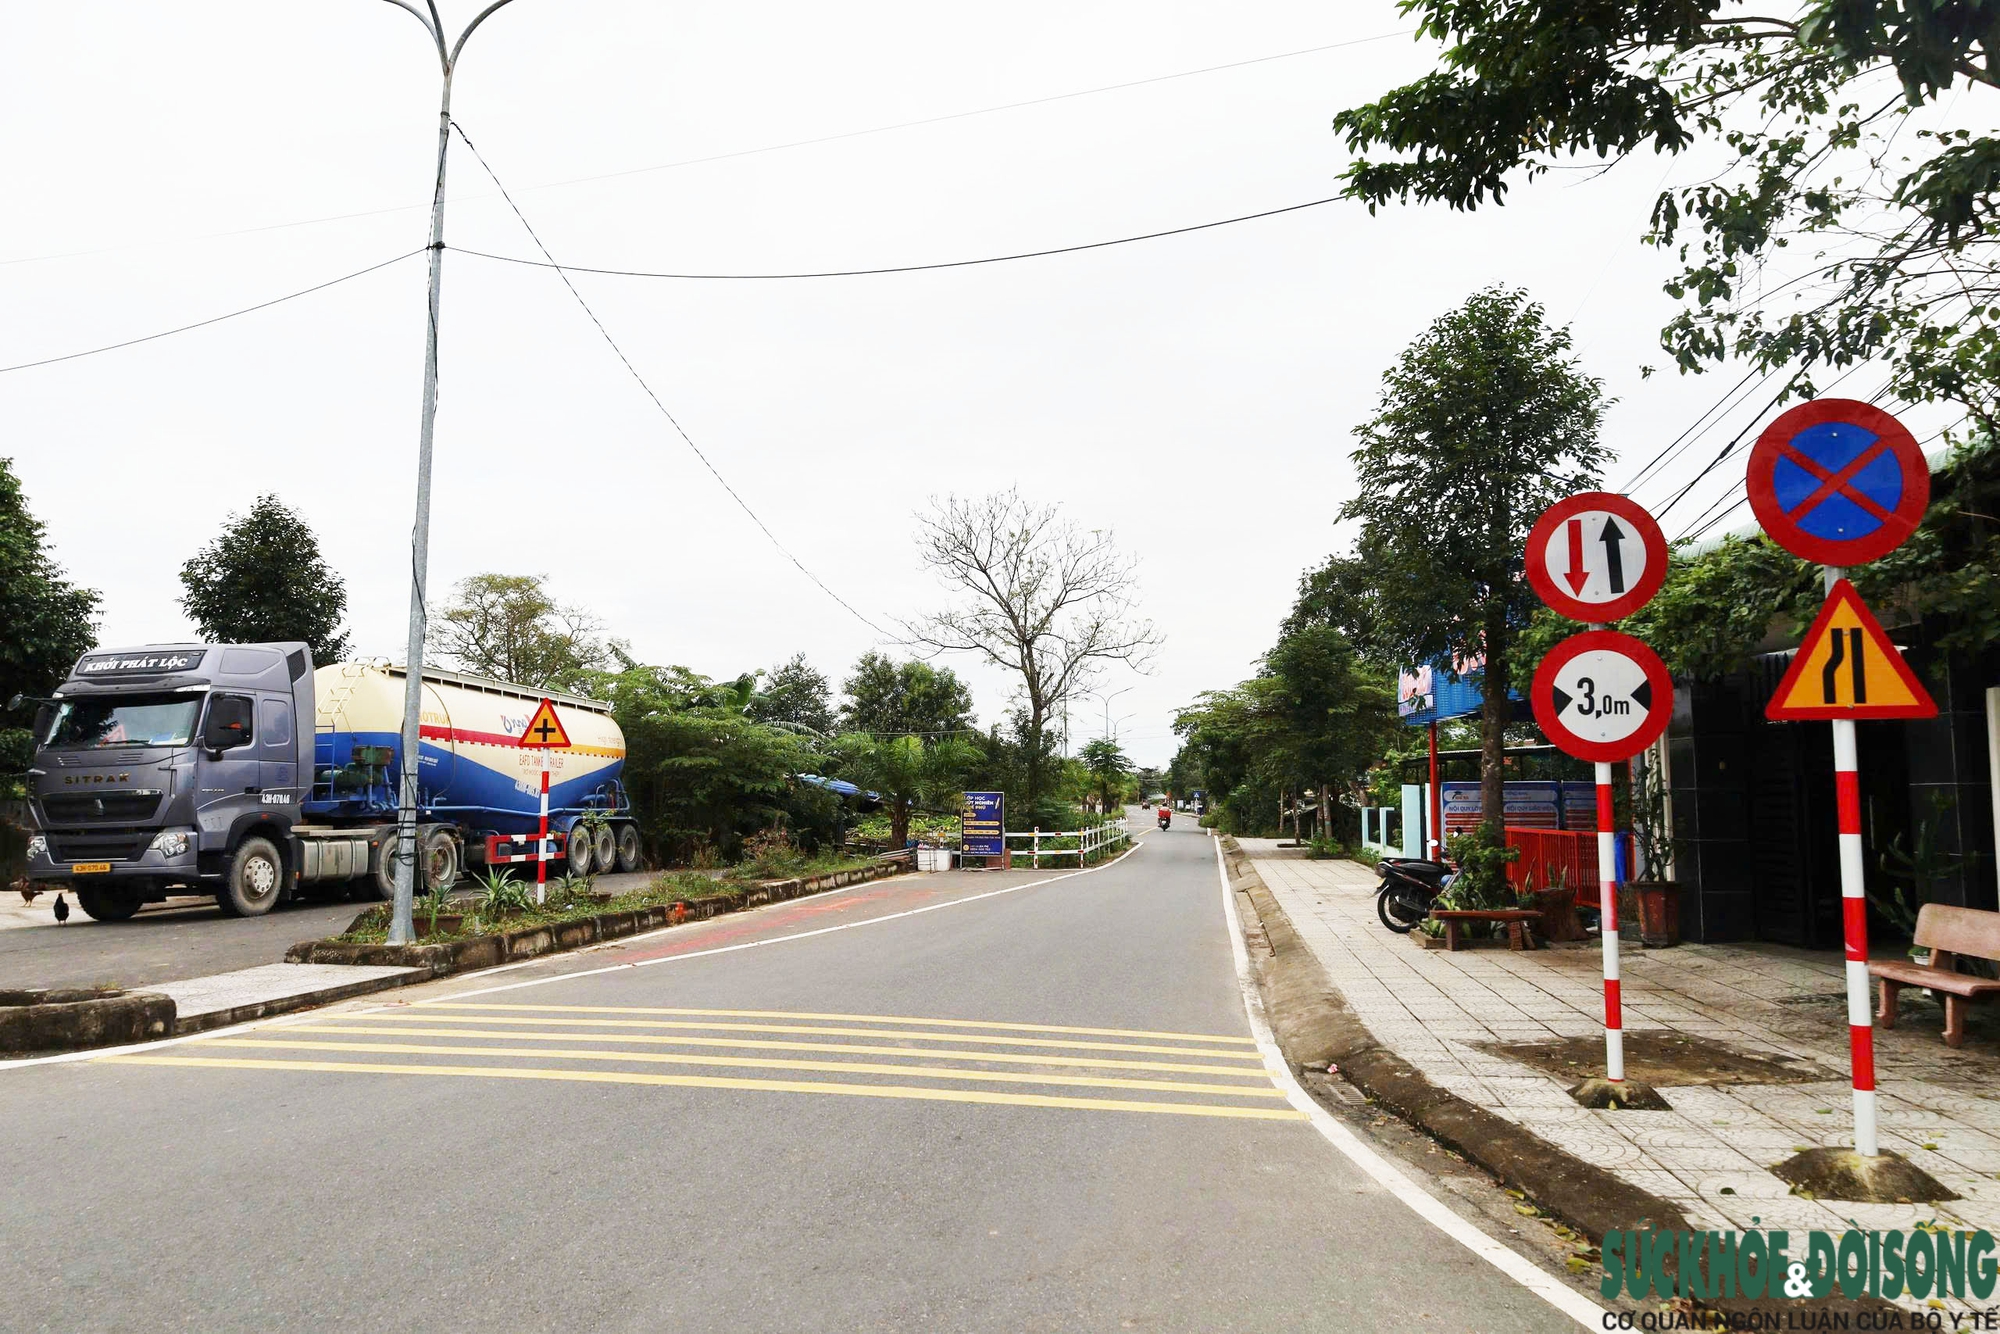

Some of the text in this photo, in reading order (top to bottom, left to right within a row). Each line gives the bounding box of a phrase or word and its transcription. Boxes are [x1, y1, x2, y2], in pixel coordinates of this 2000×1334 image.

[119, 655, 159, 669] PHÁT
[158, 655, 189, 670] LỘC
[1577, 677, 1630, 719] 3,0m
[64, 772, 130, 785] SITRAK
